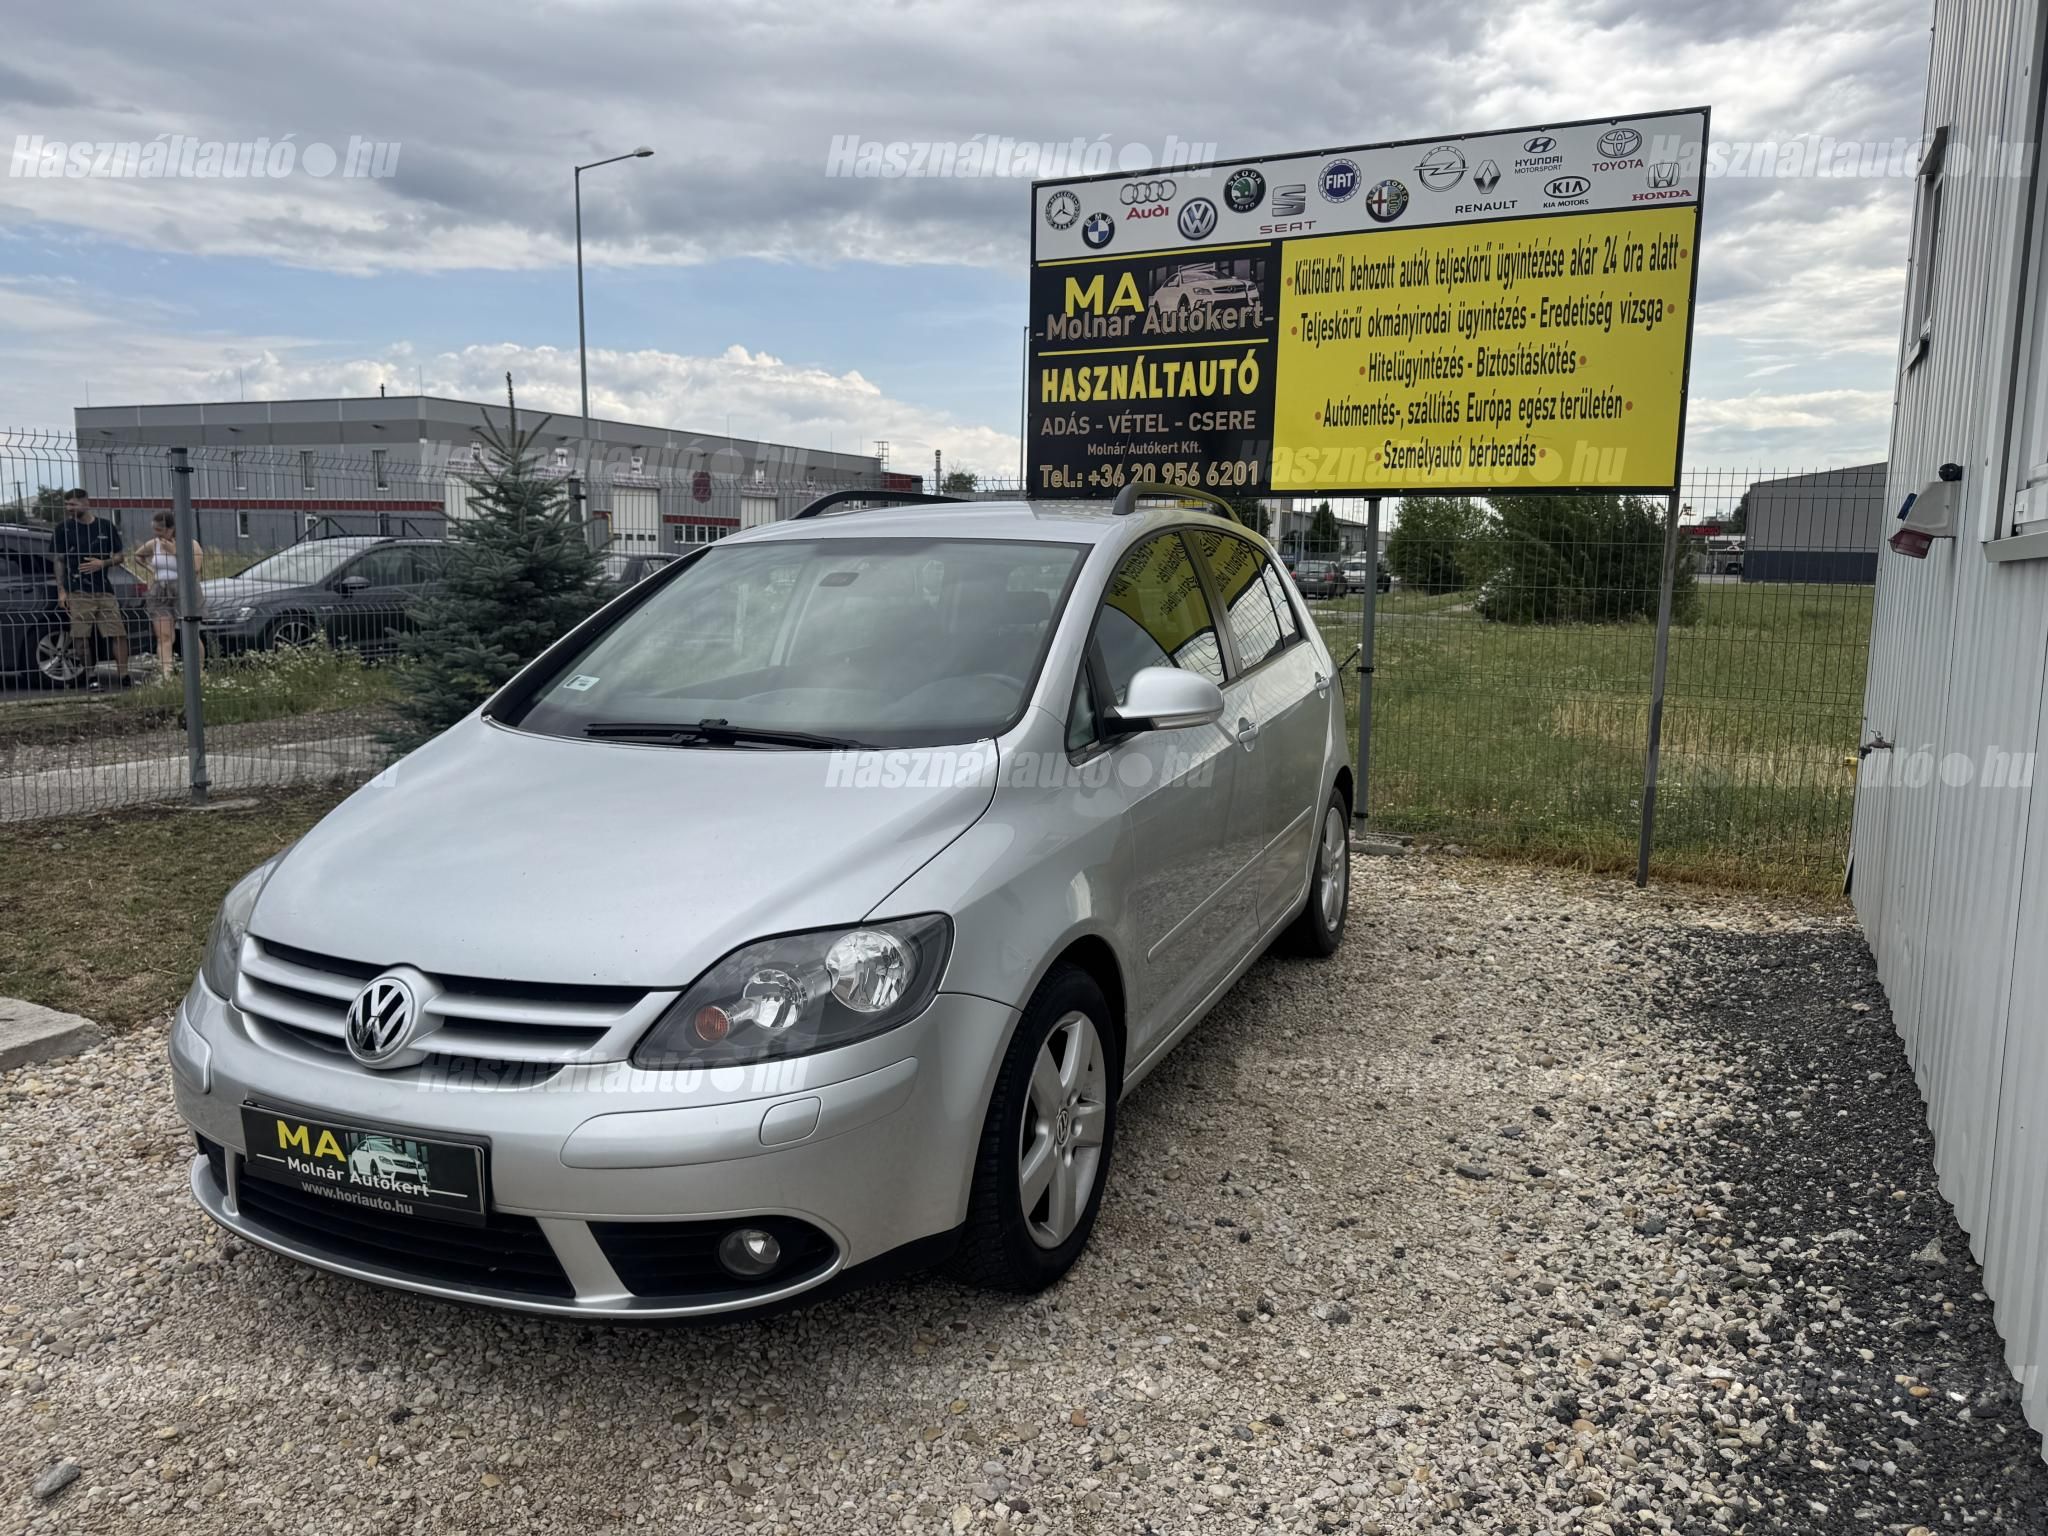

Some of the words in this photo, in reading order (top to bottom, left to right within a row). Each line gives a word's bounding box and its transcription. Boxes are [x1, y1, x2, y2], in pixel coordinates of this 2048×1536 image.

[1515, 155, 1563, 167] HYUNDAI
[1515, 165, 1562, 174] MOTORSPORT
[1592, 159, 1643, 172] TOYOTA
[1325, 172, 1354, 190] FIAT
[1552, 181, 1583, 194] KIA
[1455, 200, 1518, 214] RENAULT
[1557, 199, 1589, 207] MOTORS
[1632, 190, 1692, 201] HONDA
[1126, 206, 1169, 220] Audi
[1260, 220, 1317, 235] SEAT
[1294, 254, 1345, 296] Külföldről
[1350, 255, 1395, 291] behozott
[1400, 247, 1430, 287] autók
[1435, 241, 1492, 294] teljeskörű
[1496, 237, 1565, 290] ügyintézése
[1570, 234, 1598, 276] akár
[1603, 235, 1618, 274] 24
[1624, 231, 1644, 273] óra
[1650, 232, 1679, 271] alatt
[1065, 272, 1145, 317] MA
[1301, 306, 1362, 348] Teljeskörű
[1368, 303, 1452, 343] okmányirodai
[1457, 296, 1527, 340] ügyintézés
[1539, 291, 1613, 333] Eredetiség
[1619, 292, 1664, 332] vizsga
[1042, 349, 1259, 402] HASZNÁLTAUTÓ
[1368, 345, 1464, 388] Hitelügyintézés
[1476, 340, 1576, 378] Biztosításkötés
[1407, 390, 1460, 425] szállítás
[1466, 388, 1512, 430] Európa
[1518, 386, 1556, 429] egész
[1559, 384, 1623, 420] területén
[1041, 411, 1090, 436] ADÁS
[1108, 409, 1169, 433] VÉTEL
[1189, 410, 1256, 431] CSERE
[1087, 443, 1125, 456] Molnár
[1128, 441, 1178, 455] Autókert
[1181, 441, 1202, 455] Kft.
[1383, 435, 1462, 475] Személyautó
[1468, 433, 1537, 468] bérbeadás
[1040, 465, 1083, 488] Tel.:
[1089, 464, 1125, 488] +36
[1131, 463, 1155, 484] 20
[1162, 462, 1200, 487] 956
[1206, 461, 1258, 486] 6201
[276, 1119, 347, 1163] MA
[287, 1156, 345, 1182] Molnár
[350, 1171, 430, 1198] Autókert
[301, 1180, 414, 1215] www.horiauto.hu
